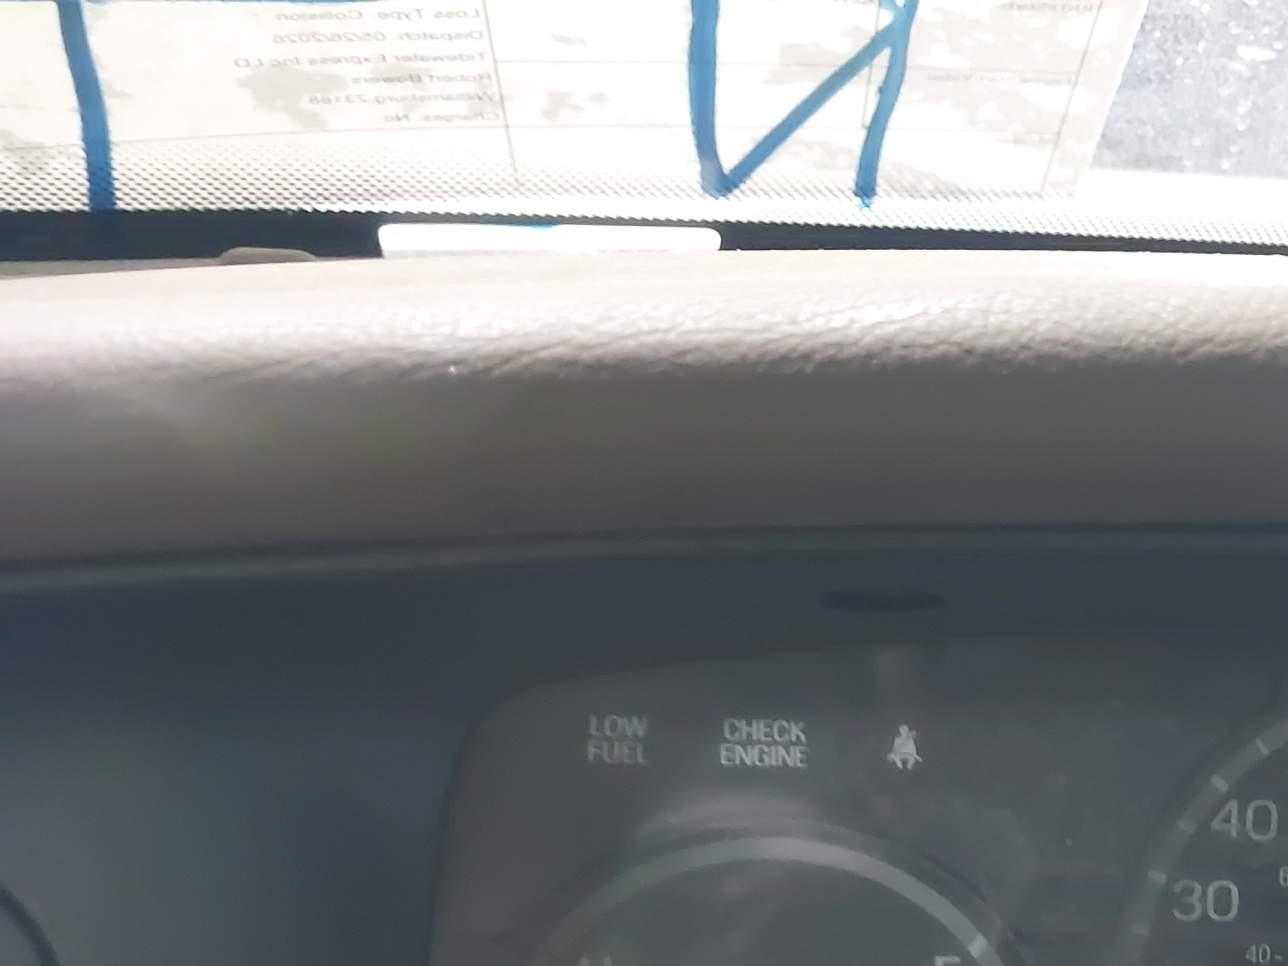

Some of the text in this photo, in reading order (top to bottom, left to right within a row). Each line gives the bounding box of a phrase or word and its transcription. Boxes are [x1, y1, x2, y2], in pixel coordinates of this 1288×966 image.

[588, 714, 648, 738] LOW
[722, 718, 807, 743] CHECK
[587, 741, 650, 765] FUEL
[719, 743, 808, 768] ENGINE
[1210, 798, 1279, 842] 40
[1171, 879, 1240, 922] 30
[1245, 944, 1272, 965] 40
